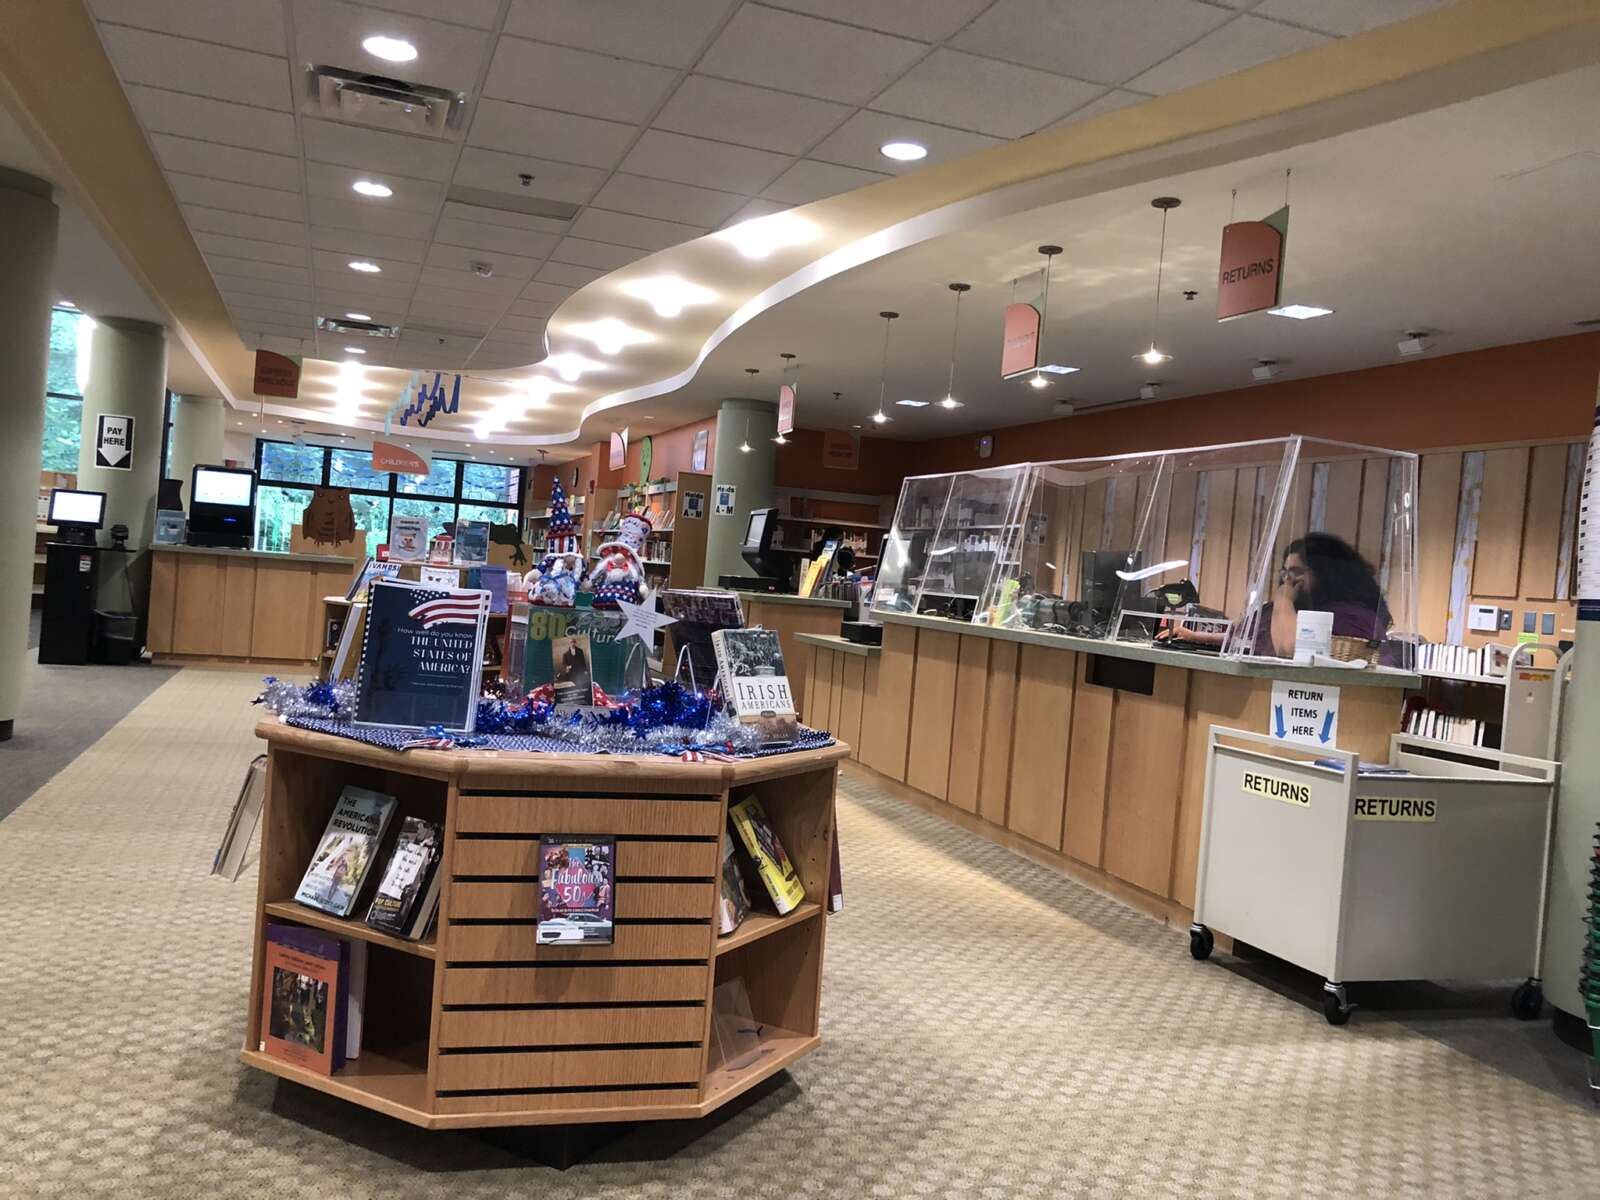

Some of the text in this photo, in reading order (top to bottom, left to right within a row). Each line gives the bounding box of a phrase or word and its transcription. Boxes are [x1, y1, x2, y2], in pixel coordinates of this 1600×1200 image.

[1222, 258, 1274, 284] RETURNS
[107, 427, 122, 435] PAY
[104, 437, 125, 446] HERE
[684, 509, 689, 517] A
[696, 510, 702, 518] M
[727, 506, 733, 514] M
[412, 636, 473, 649] THE UNITED
[413, 649, 472, 661] STATES OF
[420, 661, 471, 674] AMERICA?
[737, 682, 789, 700] IRISH
[1288, 689, 1323, 702] RETURN
[741, 700, 791, 710] AMERICANS
[1291, 707, 1318, 719] ITEMS
[1292, 725, 1314, 737] HERE
[1243, 773, 1310, 803] RETURNS
[343, 797, 358, 807] THE
[1354, 798, 1435, 818] RETURNS
